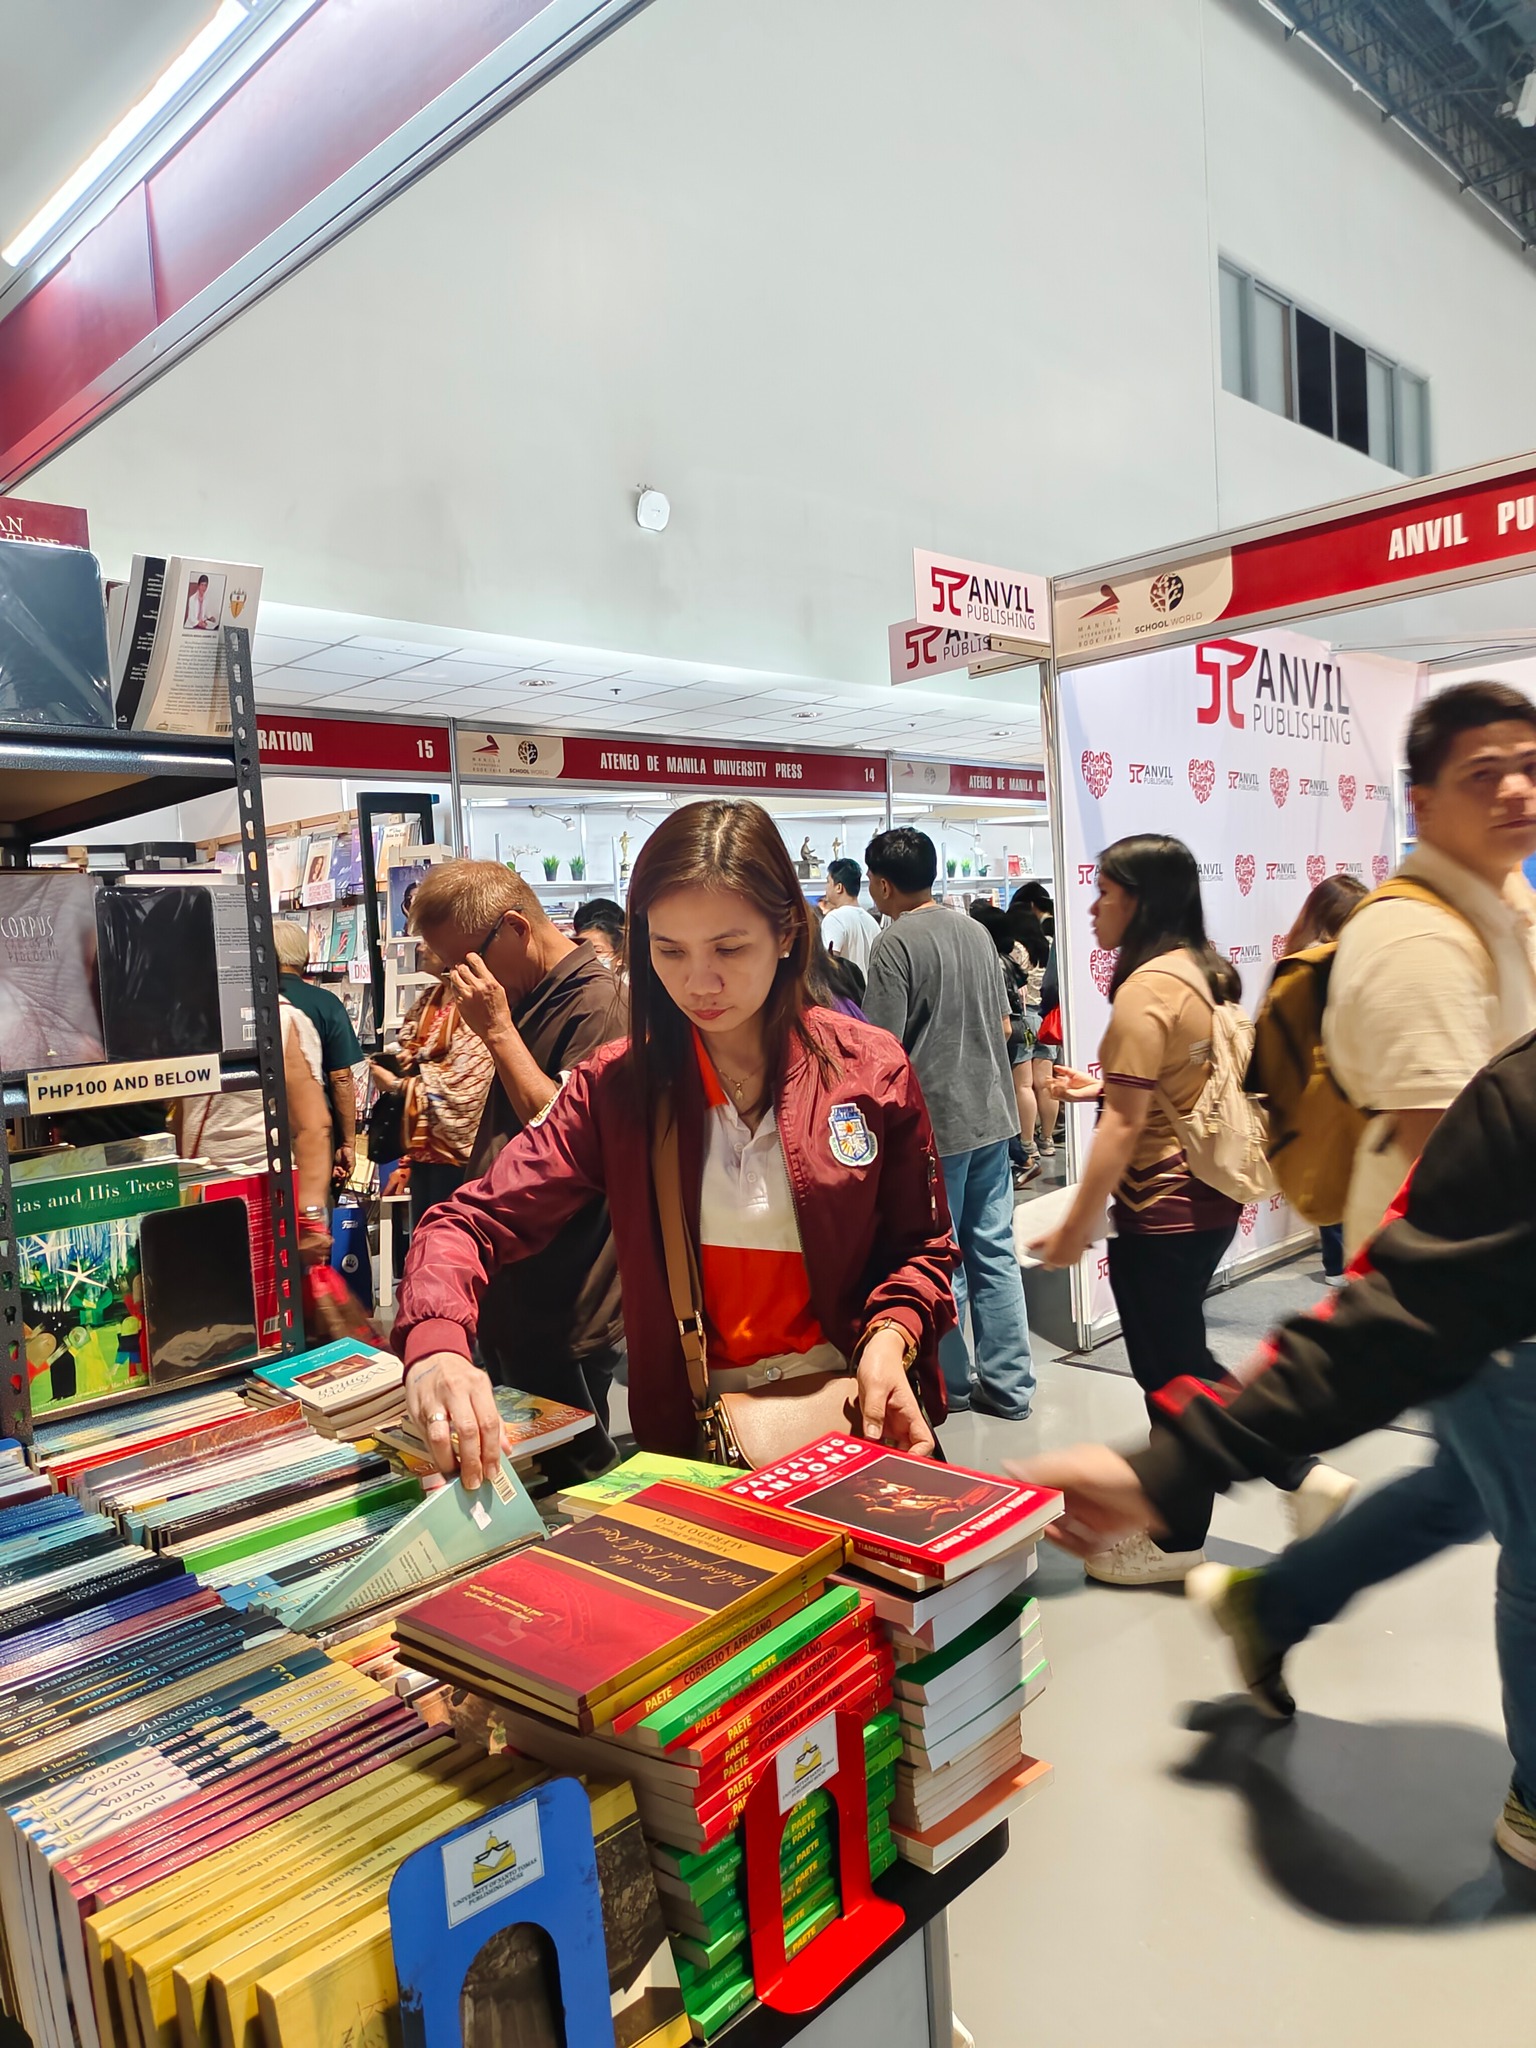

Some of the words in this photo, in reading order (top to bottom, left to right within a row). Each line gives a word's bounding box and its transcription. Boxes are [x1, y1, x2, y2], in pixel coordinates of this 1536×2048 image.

[1388, 512, 1469, 562] ANVIL
[968, 575, 1035, 614] ANVIL
[967, 603, 1035, 631] PUBLISHING
[1077, 617, 1122, 634] MANILA
[1134, 619, 1169, 635] SCHOOL
[1170, 611, 1203, 627] WORLD
[1255, 649, 1350, 716] ANVIL
[1254, 704, 1351, 746] PUBLISHING
[258, 727, 313, 753] RATION
[416, 739, 434, 758] 15
[600, 753, 639, 771] ATENEO
[647, 755, 660, 772] DE
[666, 757, 706, 775] MANILA
[713, 759, 767, 778] UNIVERSITY
[775, 762, 803, 780] PRESS
[864, 767, 875, 782] 14
[1081, 750, 1113, 766] BOOKS
[1188, 759, 1215, 773] BOOKS
[969, 775, 993, 790] ATENEO
[997, 777, 1005, 791] DE
[1009, 778, 1033, 792] MANILA
[1081, 764, 1113, 781] FILIPINO
[1085, 775, 1103, 787] MIND
[1144, 765, 1173, 779] ANVIL
[1188, 771, 1216, 787] FILIPINO
[1238, 773, 1259, 785] ANVIL
[1088, 784, 1108, 800] SOUL
[1309, 780, 1329, 791] ANVIL
[1235, 854, 1255, 867] BOOKS
[1277, 862, 1296, 874] ANVIL
[0, 915, 54, 939] CORPUS
[1240, 945, 1261, 957] ANVIL
[37, 1079, 107, 1101] PHP100
[113, 1075, 149, 1092] AND
[154, 1067, 211, 1087] BELOW
[16, 1198, 42, 1214] ias
[48, 1187, 82, 1208] and
[89, 1183, 120, 1201] His
[126, 1177, 174, 1195] Trees
[732, 1456, 815, 1494] DANGAL
[816, 1438, 845, 1454] NG
[752, 1444, 863, 1500] ANGONO
[655, 1515, 674, 1527] CO
[569, 1525, 629, 1544] Road
[688, 1527, 749, 1551] ALFREDO
[309, 1551, 337, 1565] GOD
[338, 1545, 354, 1554] OF
[590, 1553, 633, 1568] the
[857, 1540, 888, 1558] TIAMSON
[633, 1561, 686, 1583] Across
[648, 1551, 757, 1589] Philosophical
[317, 1581, 332, 1597] Tips
[122, 1619, 205, 1656] PERFORMANCE
[147, 1622, 231, 1659] PERFORMANCE
[160, 1629, 246, 1668] PERFORMANCE
[34, 1654, 119, 1693] MANAGEMENT
[61, 1657, 146, 1695] MANAGEMENT
[644, 1685, 674, 1714] PAETE
[683, 1652, 725, 1686] CORNELIO
[732, 1617, 773, 1653] AFRICANO
[73, 1665, 160, 1705] MANAGEMENT
[88, 1675, 173, 1715] MANAGEMENT
[683, 1711, 698, 1727] Mga
[751, 1653, 778, 1679] PAETE
[694, 1707, 723, 1734] PAETE
[732, 1674, 775, 1708] CORNELIO
[782, 1641, 823, 1673] AFRICANO
[727, 1714, 753, 1742] PAETE
[760, 1681, 798, 1715] CORNELIO
[802, 1647, 839, 1679] AFRICANO
[127, 1695, 214, 1738] ALINAGNAG
[135, 1705, 223, 1748] ALINAGNAG
[724, 1735, 751, 1764] PAETE
[758, 1701, 796, 1736] CORNELIO
[801, 1666, 839, 1697] AFRICANO
[723, 1753, 750, 1781] PAETE
[759, 1718, 799, 1752] CORNELIO
[805, 1684, 844, 1719] AFRICANO
[50, 1750, 89, 1770] Torres-Yu
[273, 1738, 313, 1761] Pagitan
[285, 1749, 326, 1772] Pagitan
[57, 1760, 96, 1780] Torres-Yu
[76, 1759, 129, 1785] RIVERA
[294, 1760, 335, 1783] Pagitan
[321, 1765, 362, 1788] Pagitan
[87, 1770, 142, 1797] RIVERA
[101, 1780, 156, 1808] RIVERA
[727, 1772, 754, 1801] PAETE
[112, 1794, 167, 1822] RIVERA
[284, 1812, 303, 1824] New
[270, 1822, 283, 1832] and
[313, 1824, 332, 1837] New
[791, 1808, 817, 1833] PAETE
[234, 1829, 270, 1851] Selected
[296, 1834, 310, 1846] and
[336, 1836, 357, 1849] New
[792, 1820, 817, 1845] PAETE
[207, 1847, 233, 1864] Poems
[265, 1842, 296, 1864] Selected
[320, 1846, 335, 1858] and
[363, 1852, 379, 1868] and
[378, 1845, 396, 1859] New
[796, 1838, 820, 1864] PAETE
[235, 1860, 263, 1877] Poems
[288, 1853, 321, 1875] Selected
[331, 1861, 364, 1886] Selected
[794, 1859, 819, 1886] PAETE
[259, 1872, 288, 1891] Poems
[300, 1880, 332, 1901] Poems
[452, 1884, 489, 1908] UNIVERSITY
[496, 1869, 518, 1884] SANTO
[517, 1857, 538, 1873] TOMAS
[467, 1883, 504, 1906] PUBLISHING
[503, 1873, 524, 1887] HOUSE
[335, 1890, 363, 1908] Poems
[792, 1925, 817, 1953] PAETE
